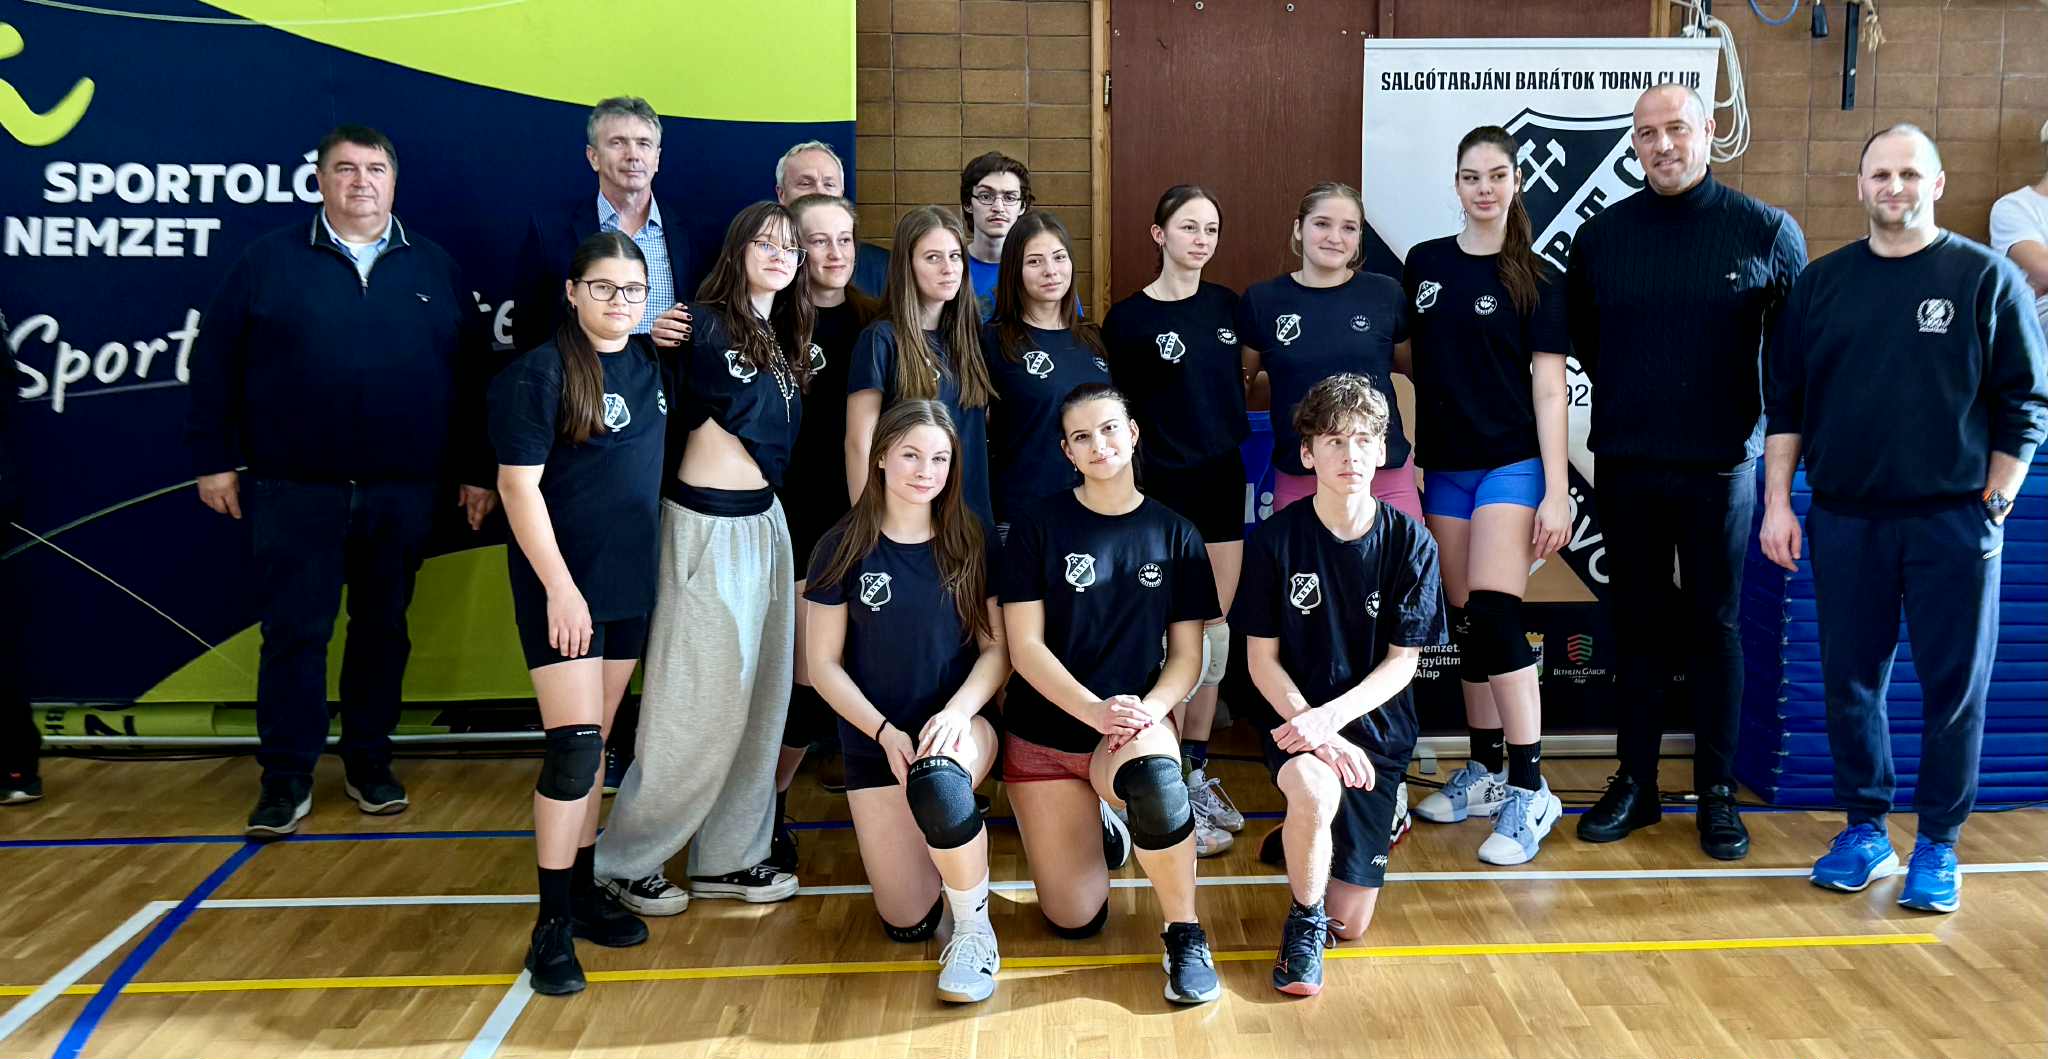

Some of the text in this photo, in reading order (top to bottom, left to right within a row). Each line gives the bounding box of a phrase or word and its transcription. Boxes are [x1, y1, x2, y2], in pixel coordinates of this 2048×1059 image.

[1381, 67, 1511, 91] SALGÓTARJÁNI
[1515, 67, 1595, 91] BARÁTOK
[1599, 71, 1652, 90] TORNA
[43, 150, 323, 204] SPORTOLÓ
[5, 216, 221, 257] NEMZET
[8, 308, 201, 414] Sport
[1414, 668, 1440, 680] Alap
